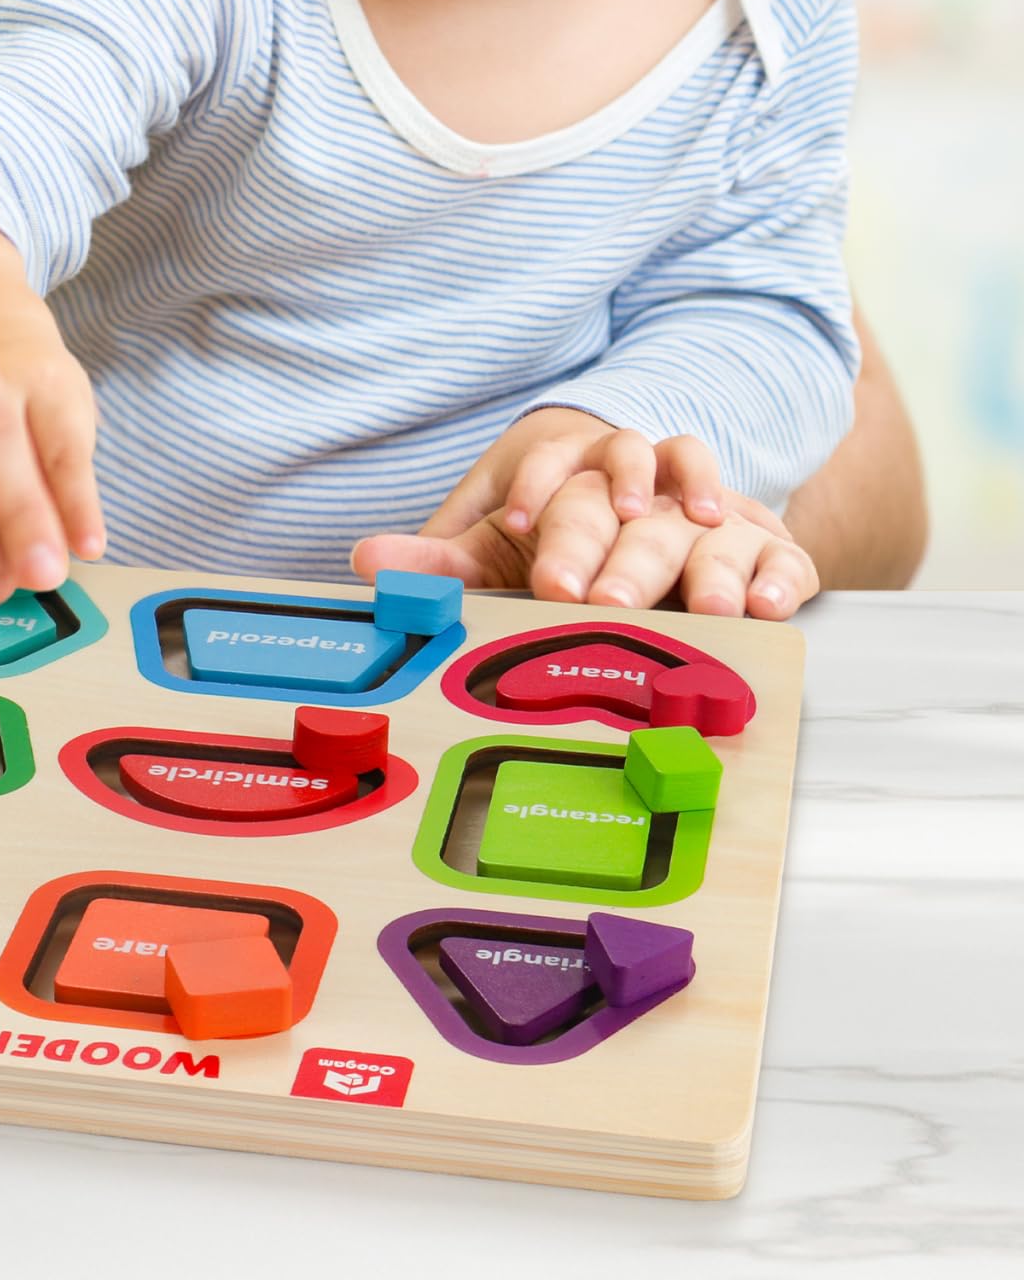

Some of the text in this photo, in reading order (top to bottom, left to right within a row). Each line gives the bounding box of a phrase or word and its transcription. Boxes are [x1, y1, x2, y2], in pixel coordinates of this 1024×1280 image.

[207, 630, 367, 654] trapezoid
[547, 663, 647, 687] heart
[148, 764, 329, 790] semicircle
[503, 803, 645, 826] rectangle
[92, 936, 170, 957] are
[318, 1058, 396, 1076] Coogam
